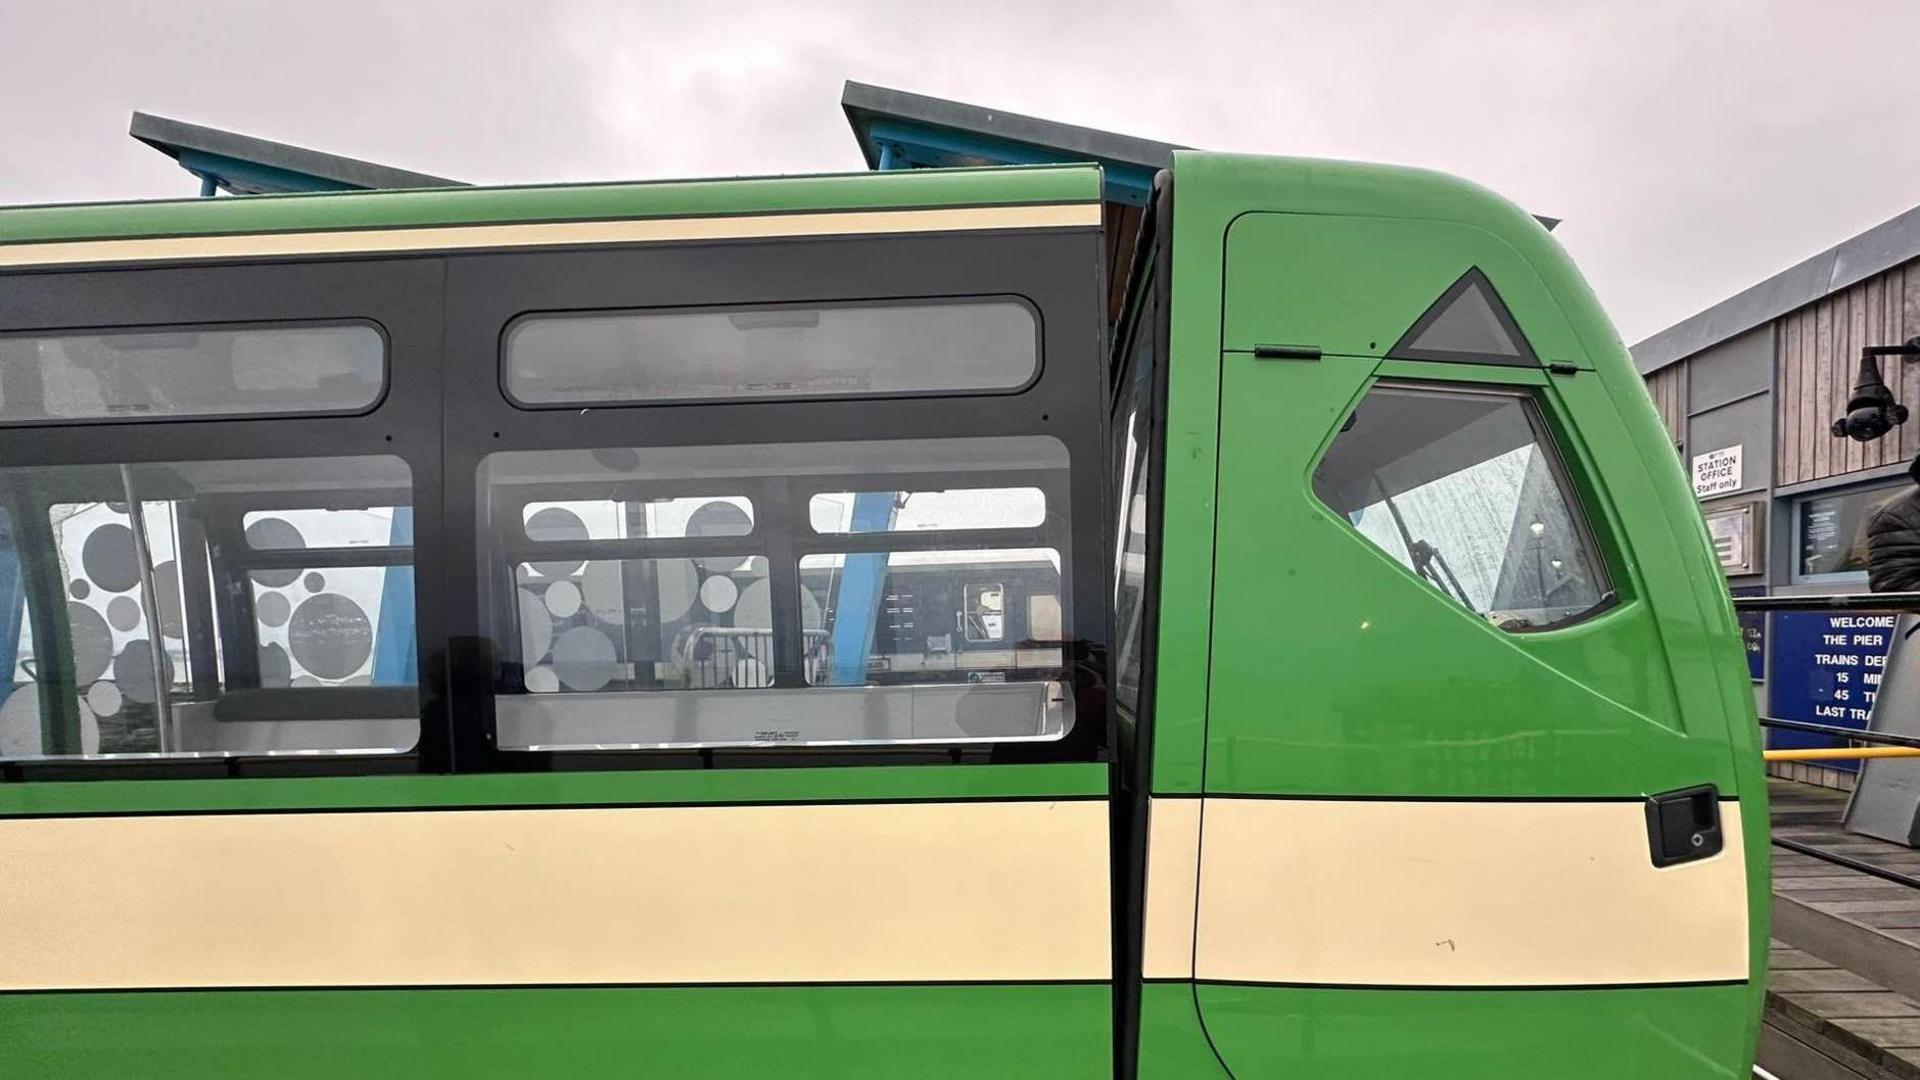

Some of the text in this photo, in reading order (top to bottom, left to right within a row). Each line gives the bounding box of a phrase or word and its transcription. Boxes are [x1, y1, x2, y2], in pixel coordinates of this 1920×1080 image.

[1698, 456, 1736, 472] STATION
[1700, 466, 1732, 481] OFFICE
[1697, 479, 1736, 494] Staff only
[1830, 616, 1894, 628] WELCOME
[1823, 634, 1883, 646] THE PIER
[1815, 654, 1859, 665] TRAINS
[1836, 672, 1849, 683] 15
[1834, 689, 1849, 700] 45
[1815, 705, 1846, 717] LAST
